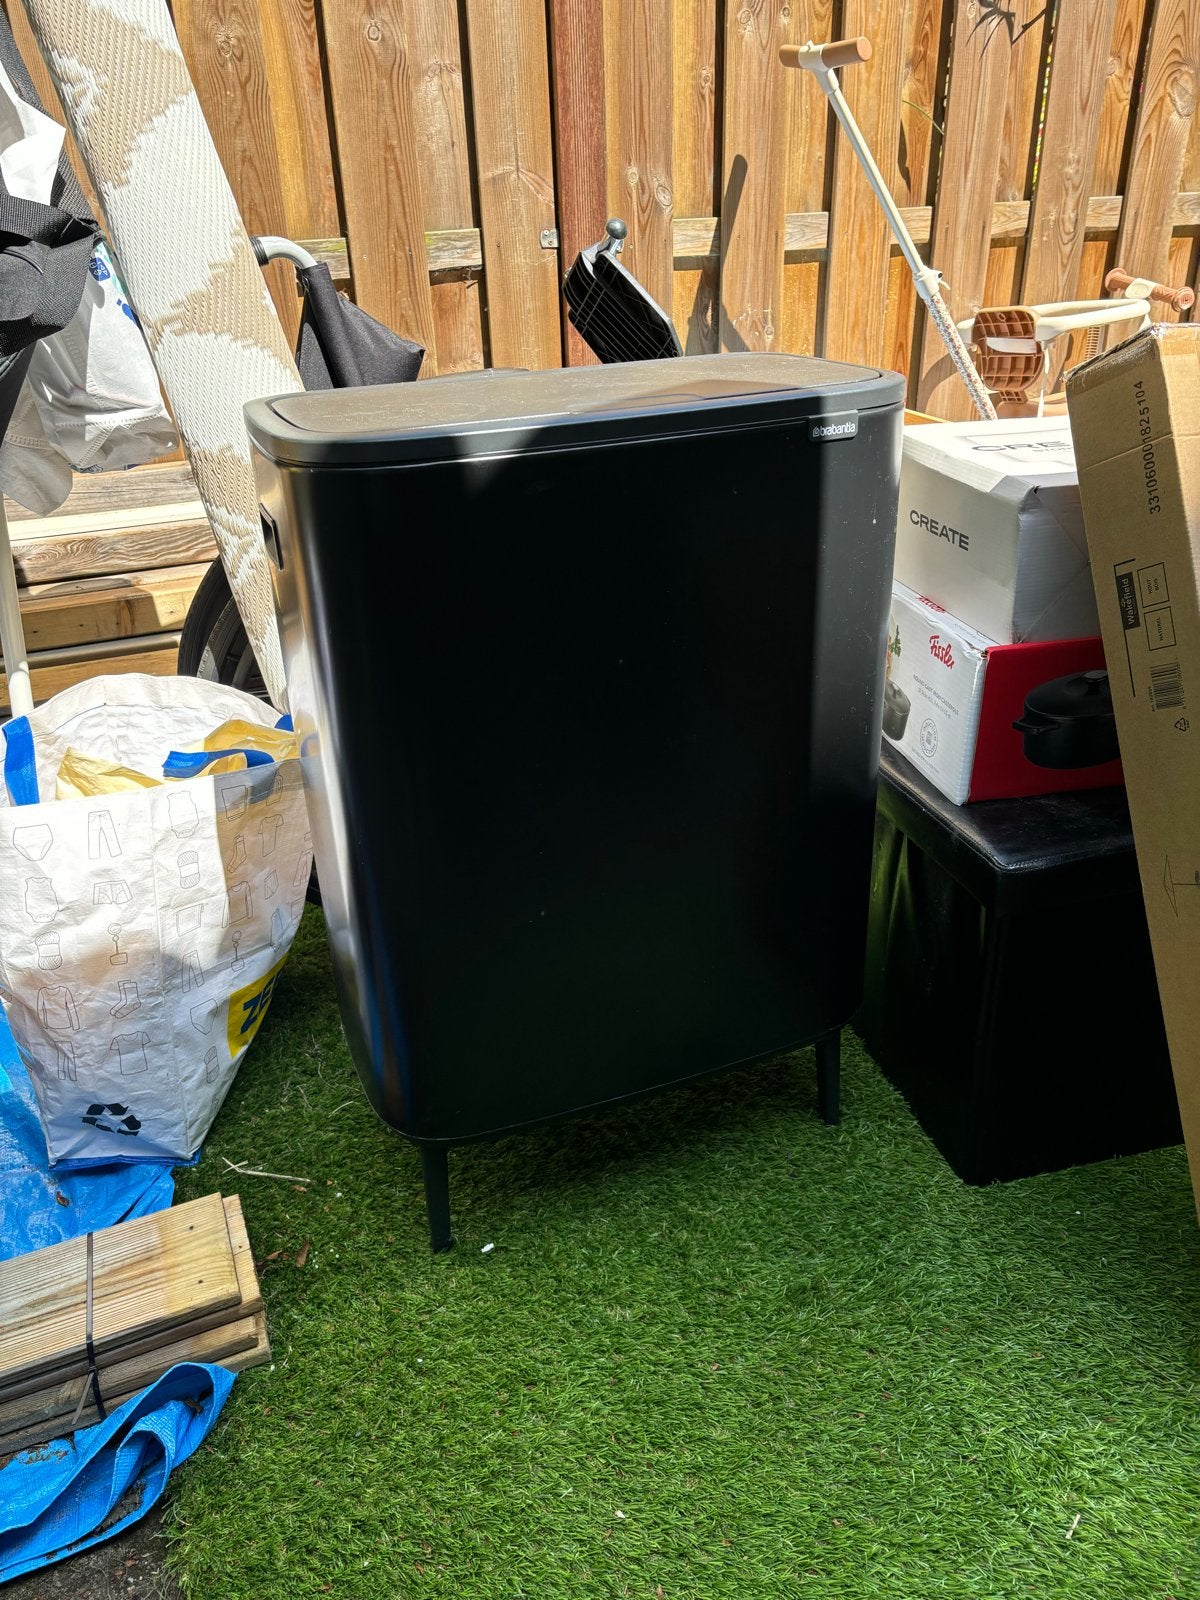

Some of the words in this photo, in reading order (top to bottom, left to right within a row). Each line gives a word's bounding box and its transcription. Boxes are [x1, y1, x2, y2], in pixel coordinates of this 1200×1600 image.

[820, 421, 856, 437] brabantia
[909, 509, 969, 552] CREATE
[1121, 578, 1136, 625] Wakefield
[929, 635, 955, 670] Fissler
